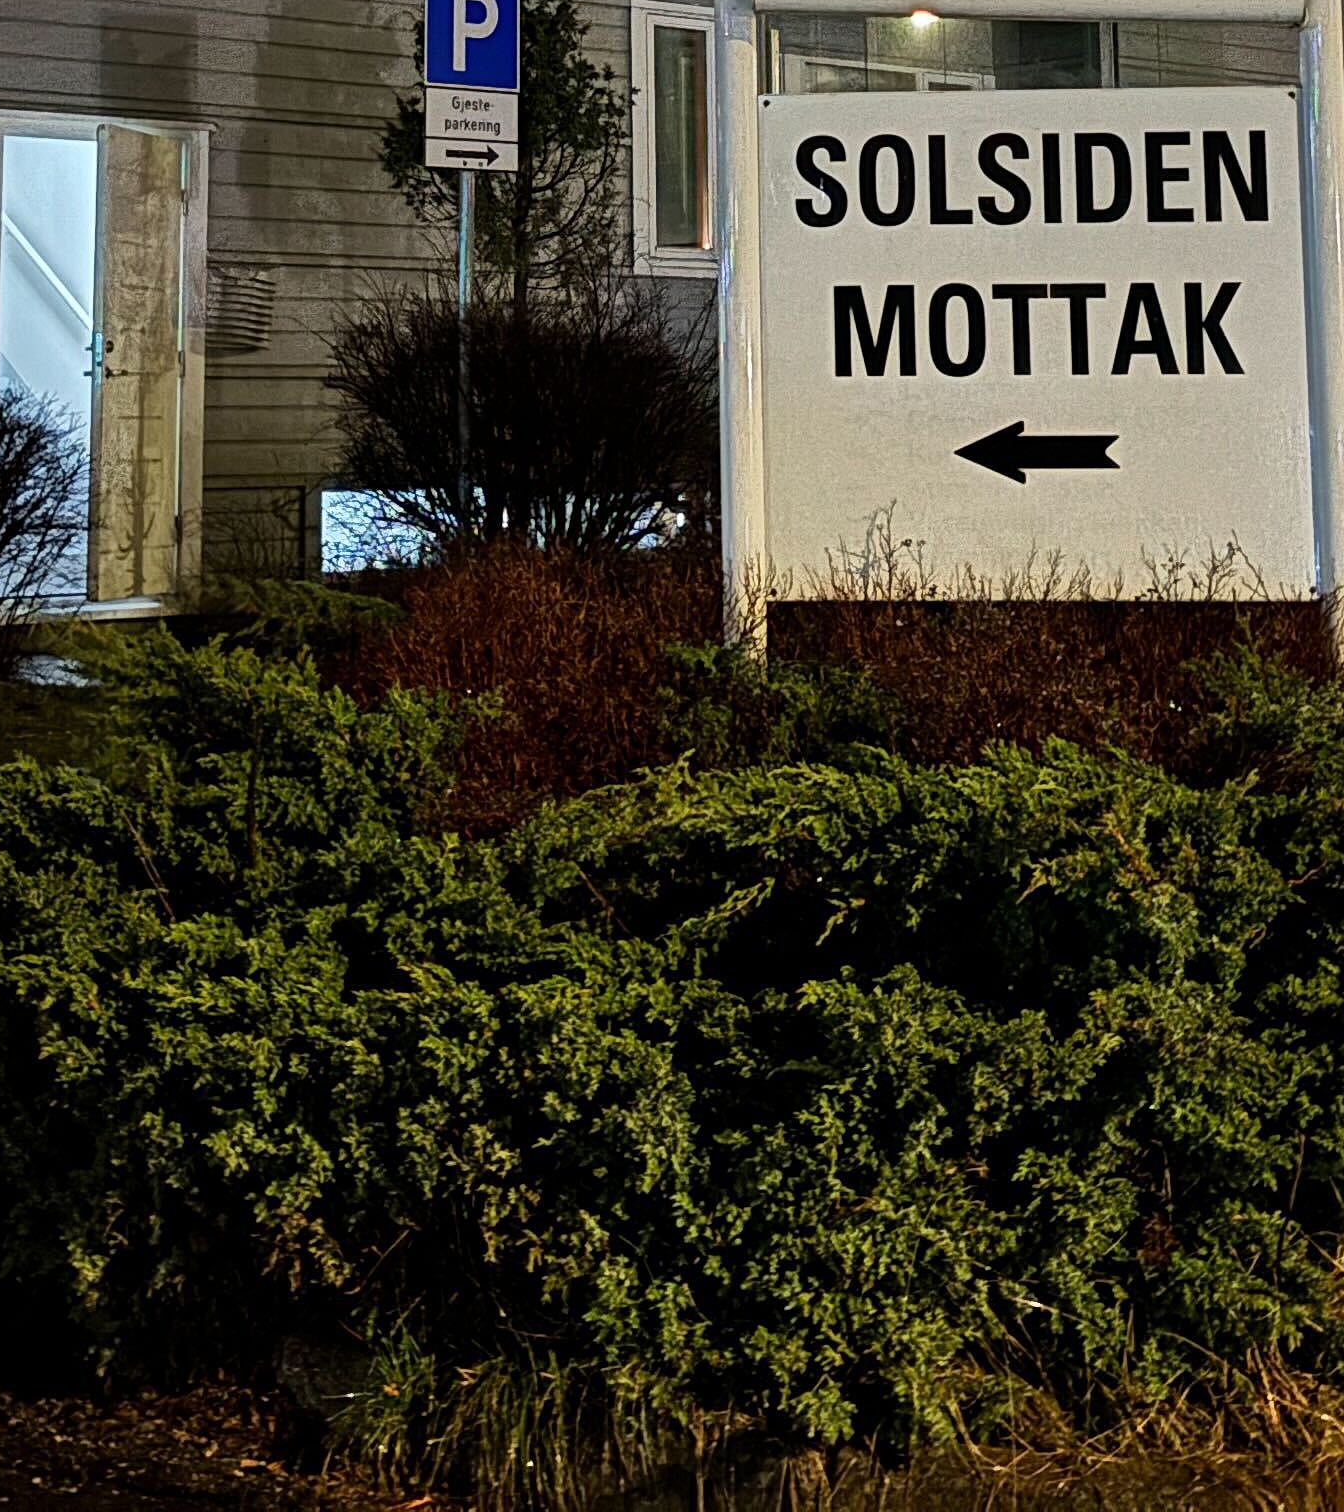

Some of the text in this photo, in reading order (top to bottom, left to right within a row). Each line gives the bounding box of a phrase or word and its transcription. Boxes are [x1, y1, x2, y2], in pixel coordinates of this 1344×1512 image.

[444, 118, 501, 136] parkering
[451, 95, 495, 113] Gjeste-
[795, 130, 1270, 228] SOLSIDEN
[833, 281, 1245, 377] MOTTAK
